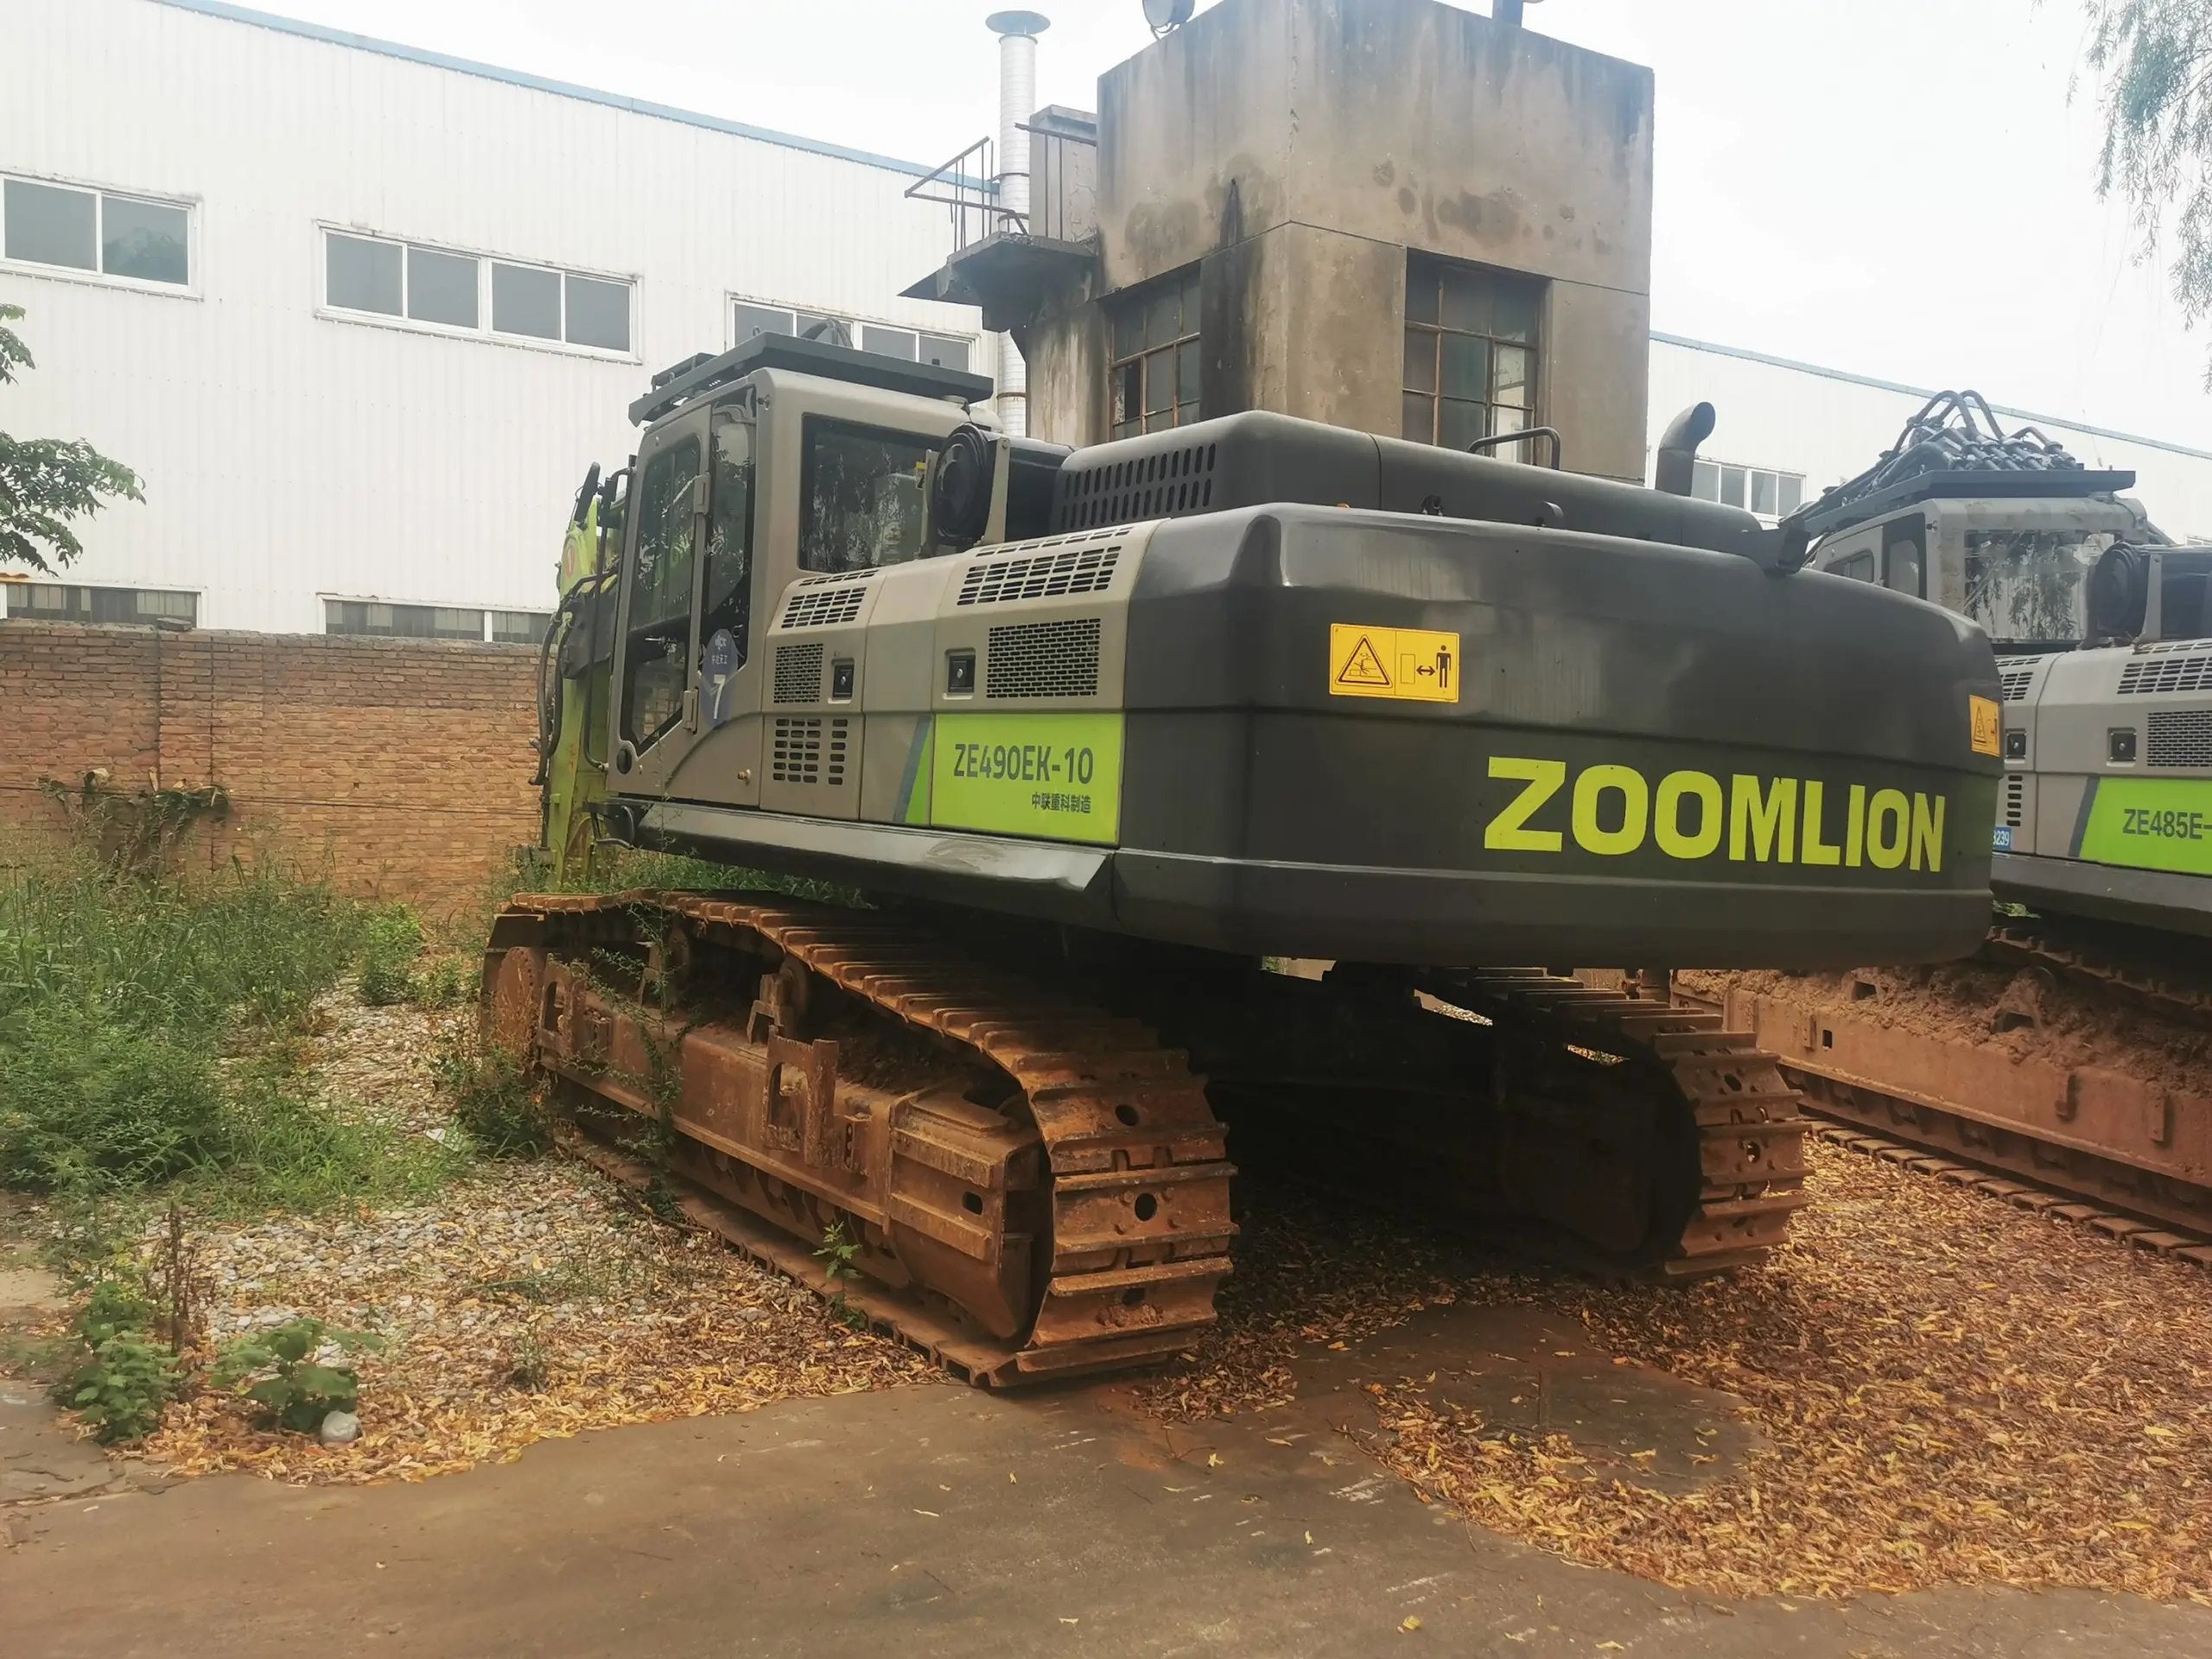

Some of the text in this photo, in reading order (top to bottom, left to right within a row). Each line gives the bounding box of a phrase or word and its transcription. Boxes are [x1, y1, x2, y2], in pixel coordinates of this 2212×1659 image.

[953, 743, 1094, 785] ZE490EK-10
[1032, 791, 1091, 814] 中联重科制造
[1484, 756, 1946, 873] ZOOMLION
[2122, 808, 2212, 840] ZE485E-
